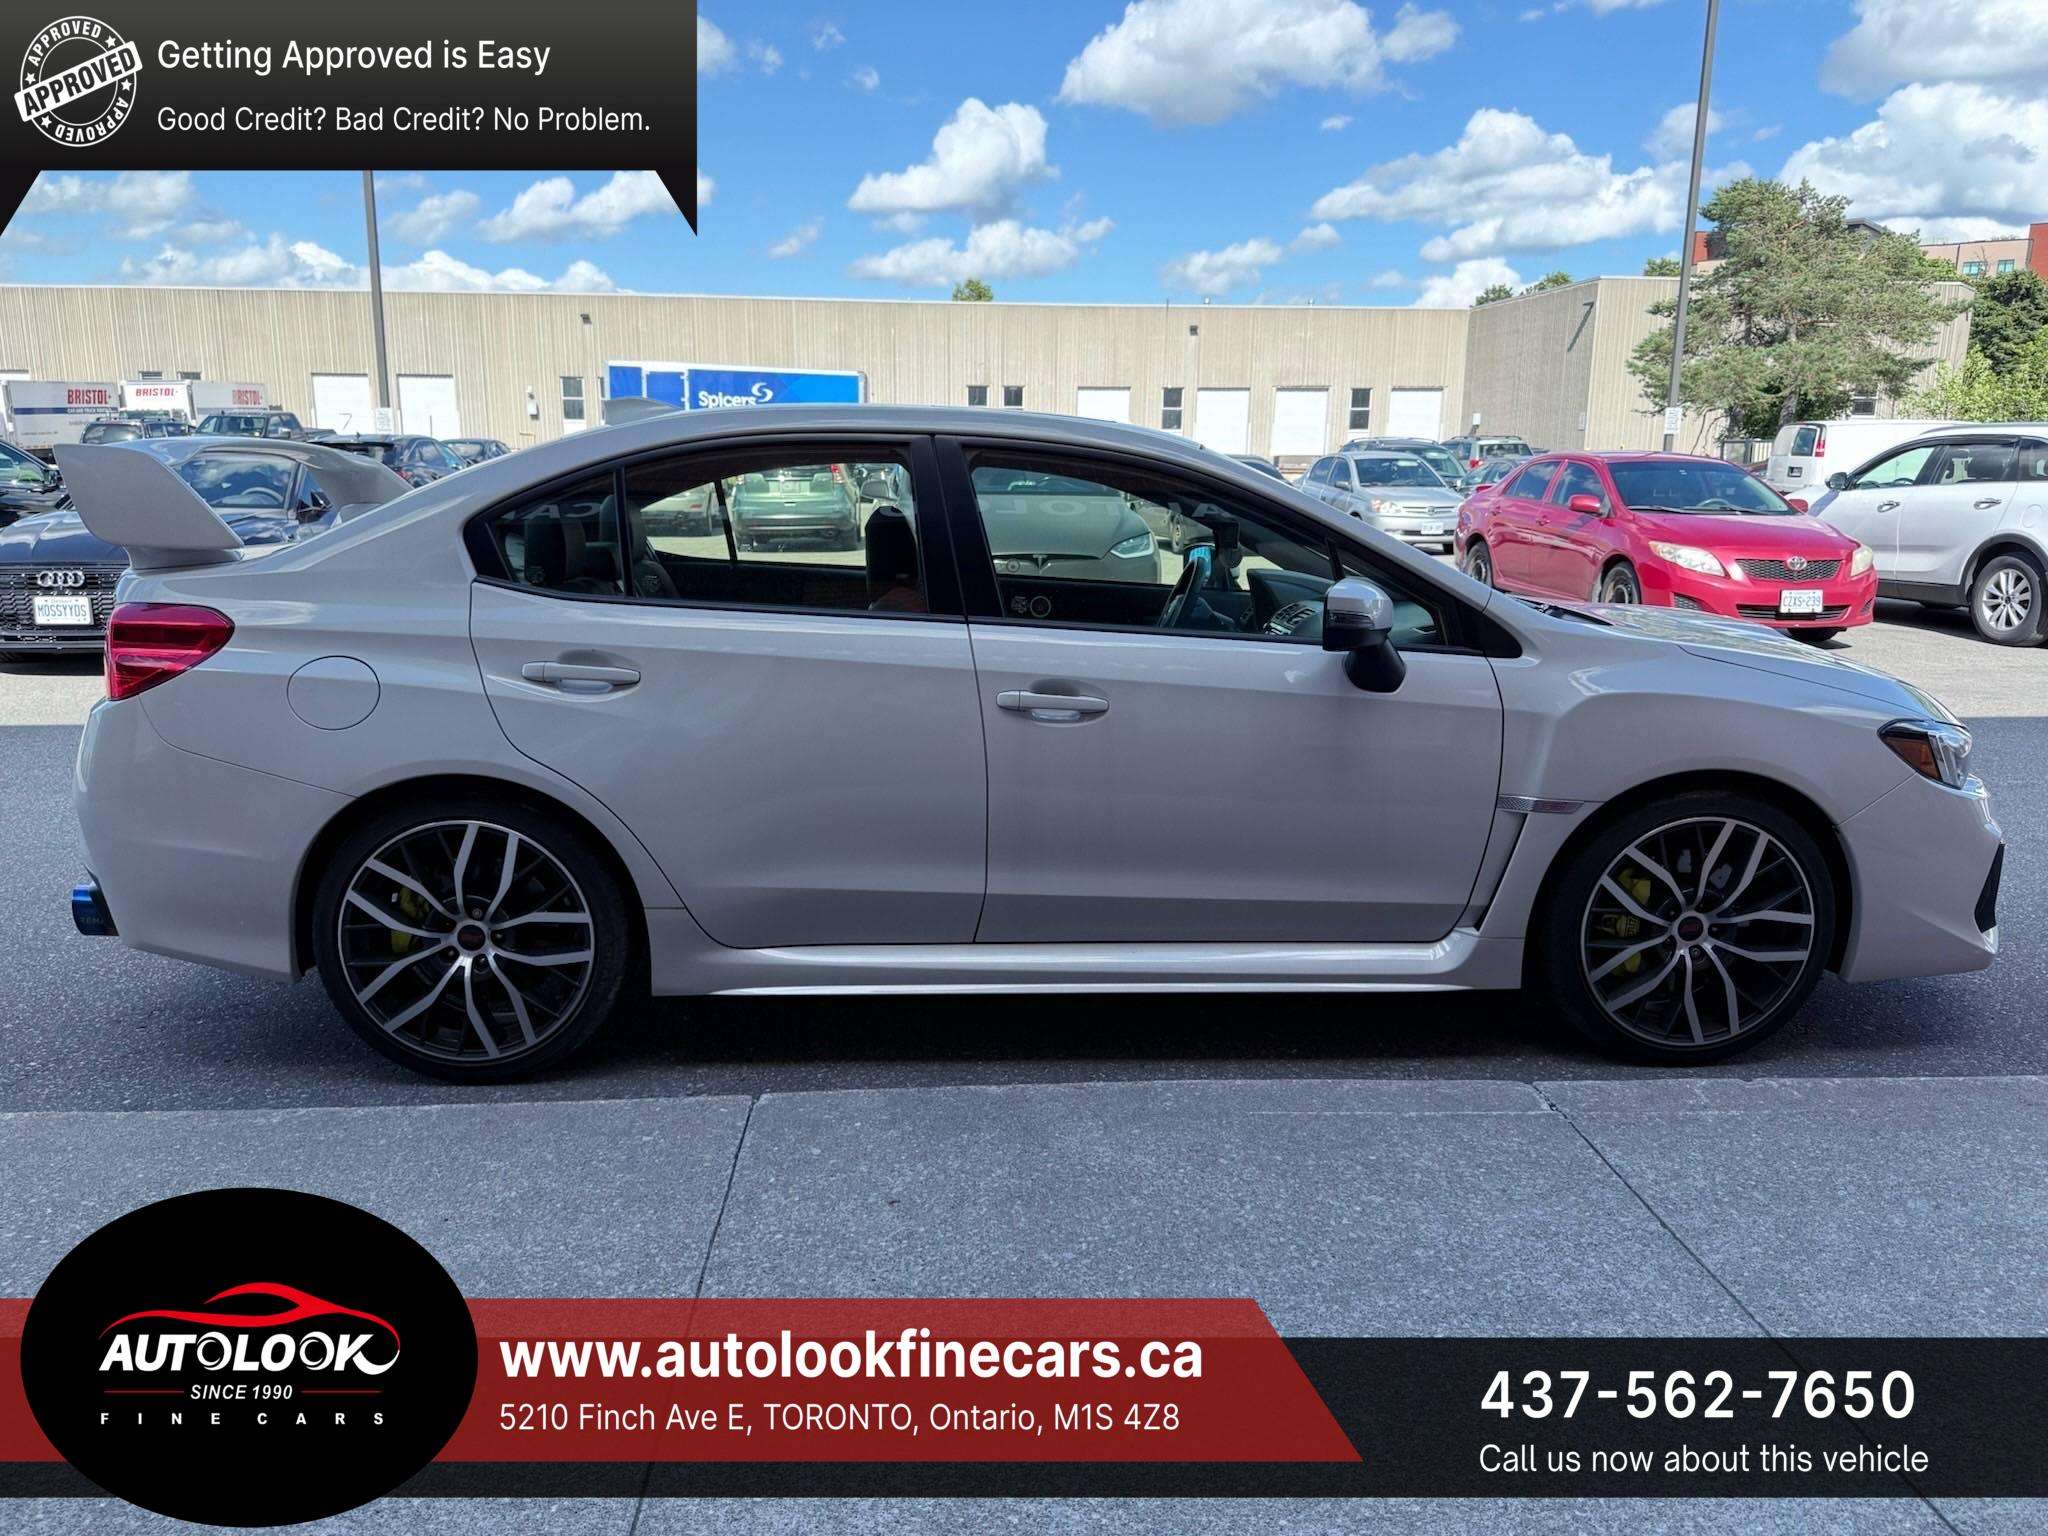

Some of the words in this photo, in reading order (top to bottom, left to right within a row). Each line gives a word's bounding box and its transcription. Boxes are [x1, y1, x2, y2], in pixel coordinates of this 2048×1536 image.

[67, 389, 108, 404] BRISTOL
[135, 388, 174, 396] BRISTOL
[698, 390, 757, 408] Spicers
